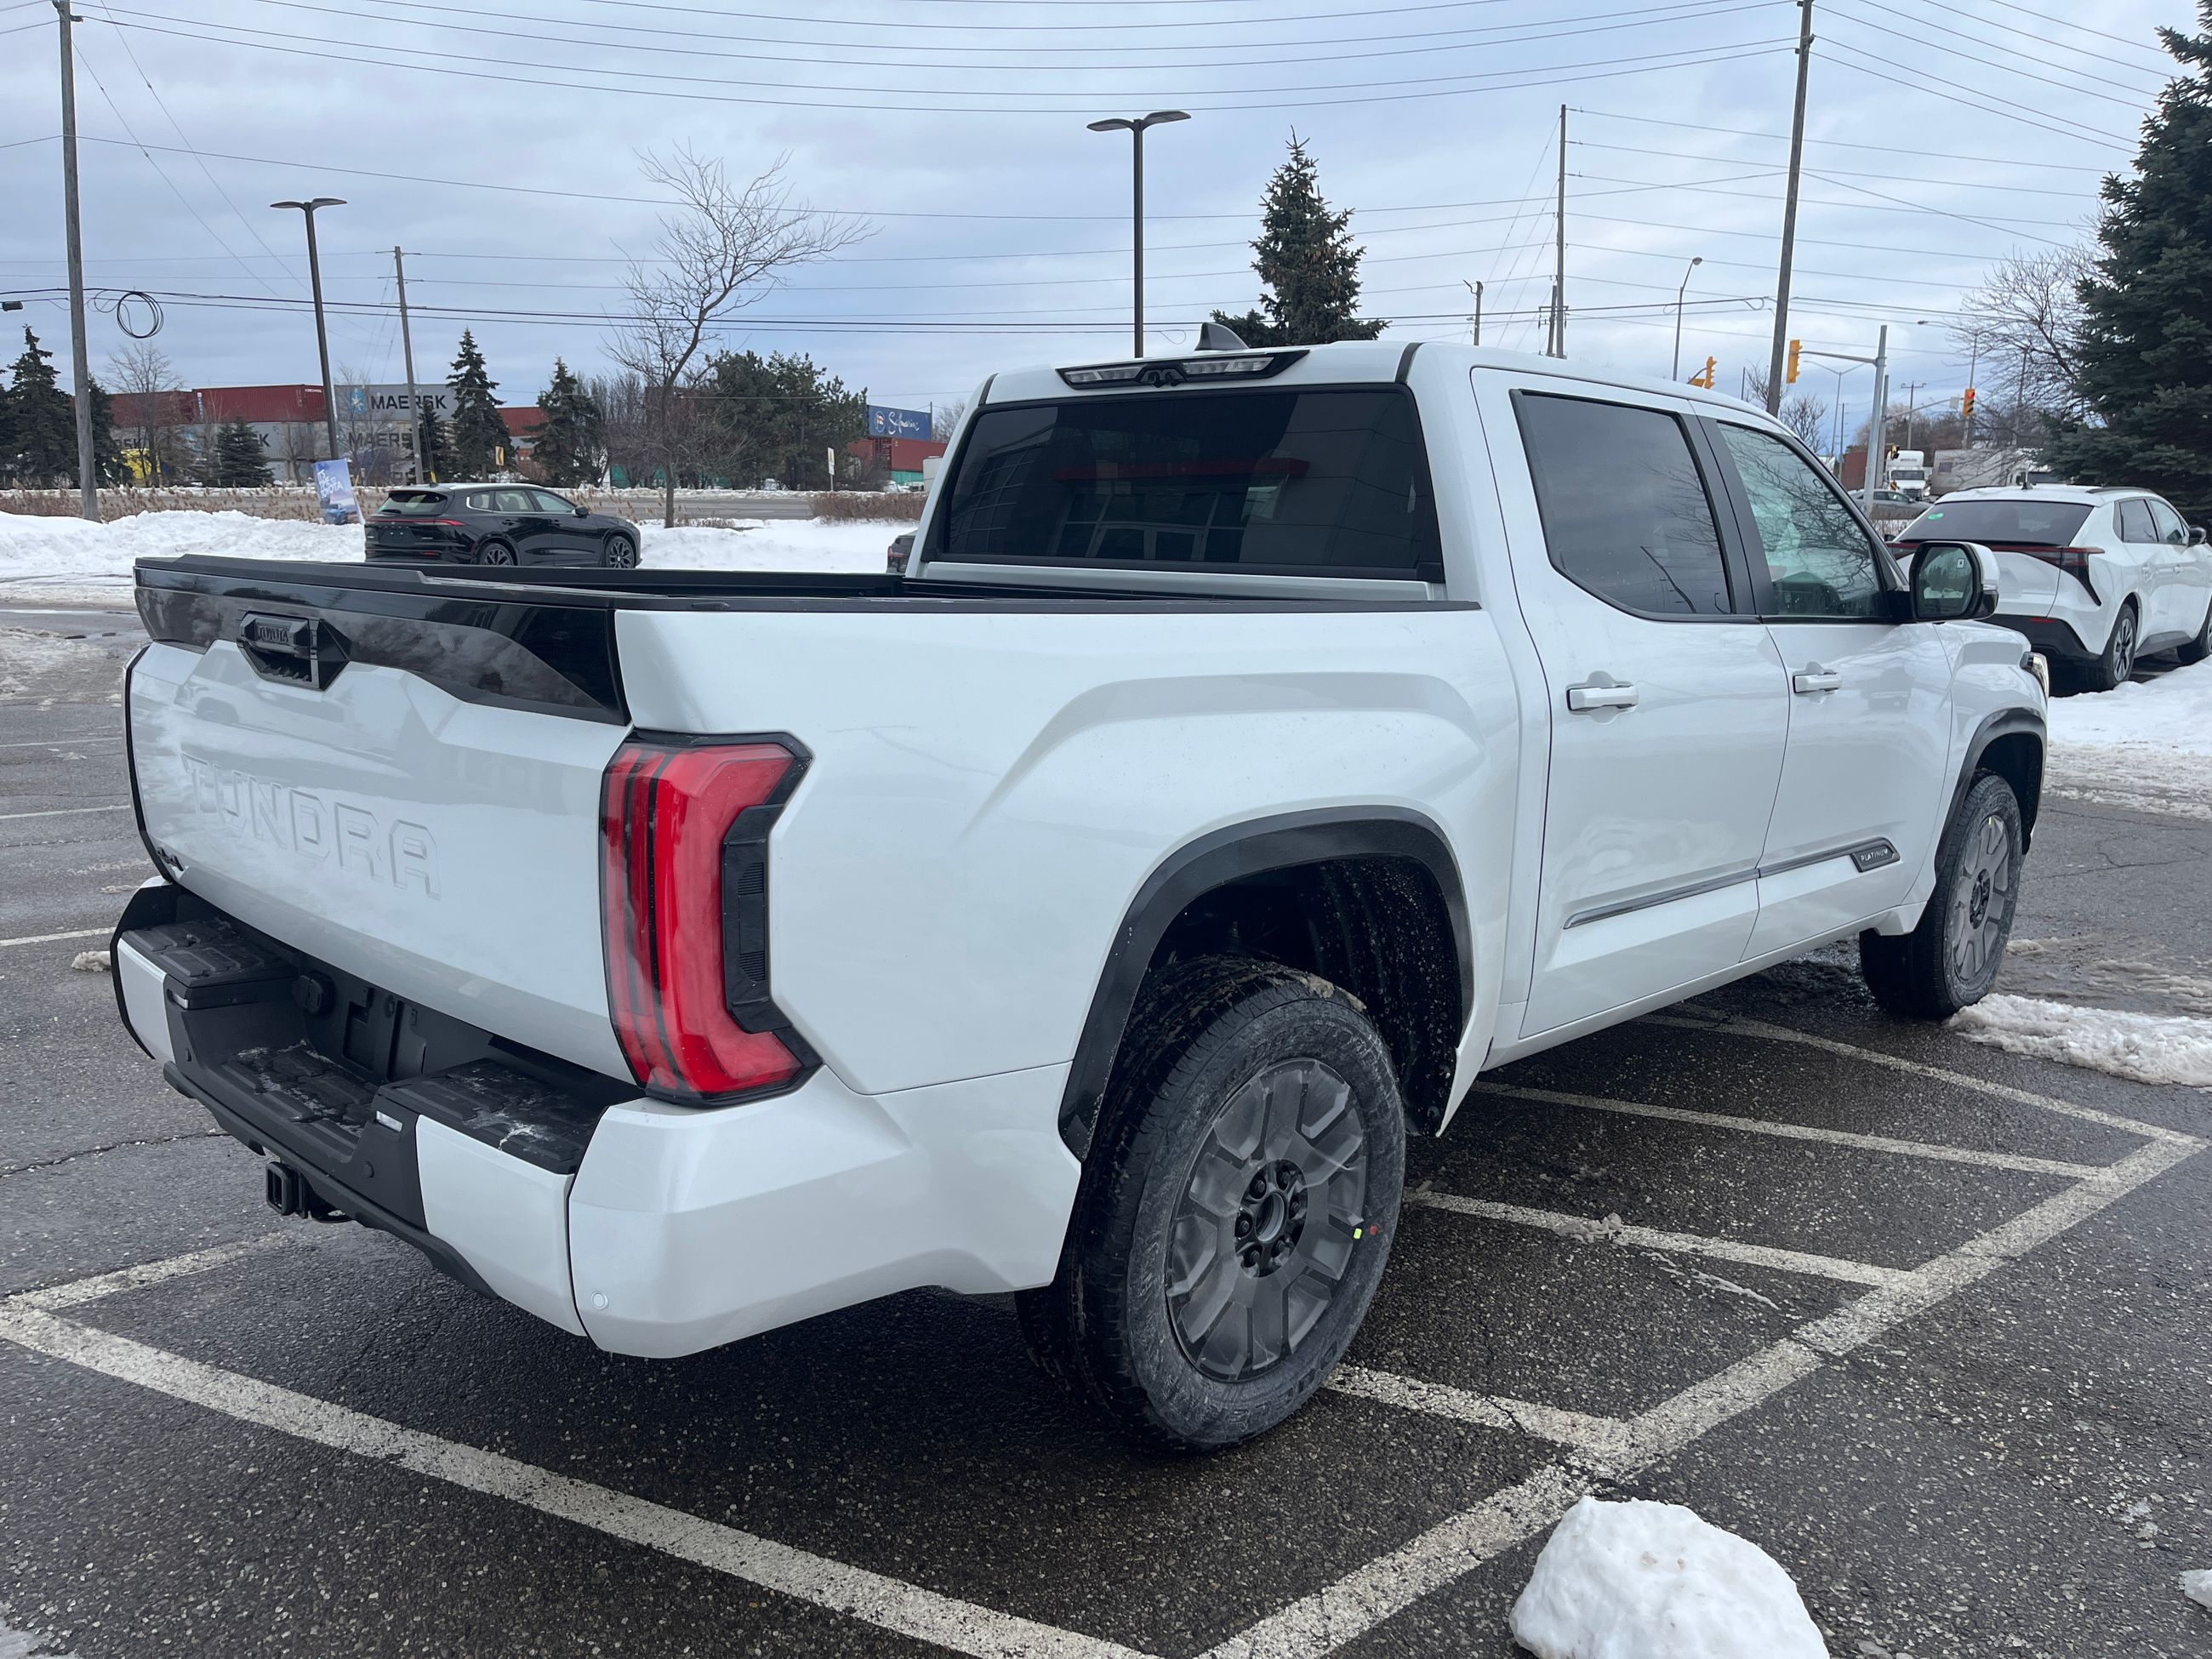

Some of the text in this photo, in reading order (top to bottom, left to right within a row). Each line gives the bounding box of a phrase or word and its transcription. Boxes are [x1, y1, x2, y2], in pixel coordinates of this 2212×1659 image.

[371, 395, 448, 410] MAERSK
[349, 432, 413, 447] MAERS
[320, 481, 344, 499] TOYOTA
[259, 625, 290, 643] TOYOTA
[180, 752, 442, 901] TUNDRA
[1860, 848, 1888, 862] PLATINUM
